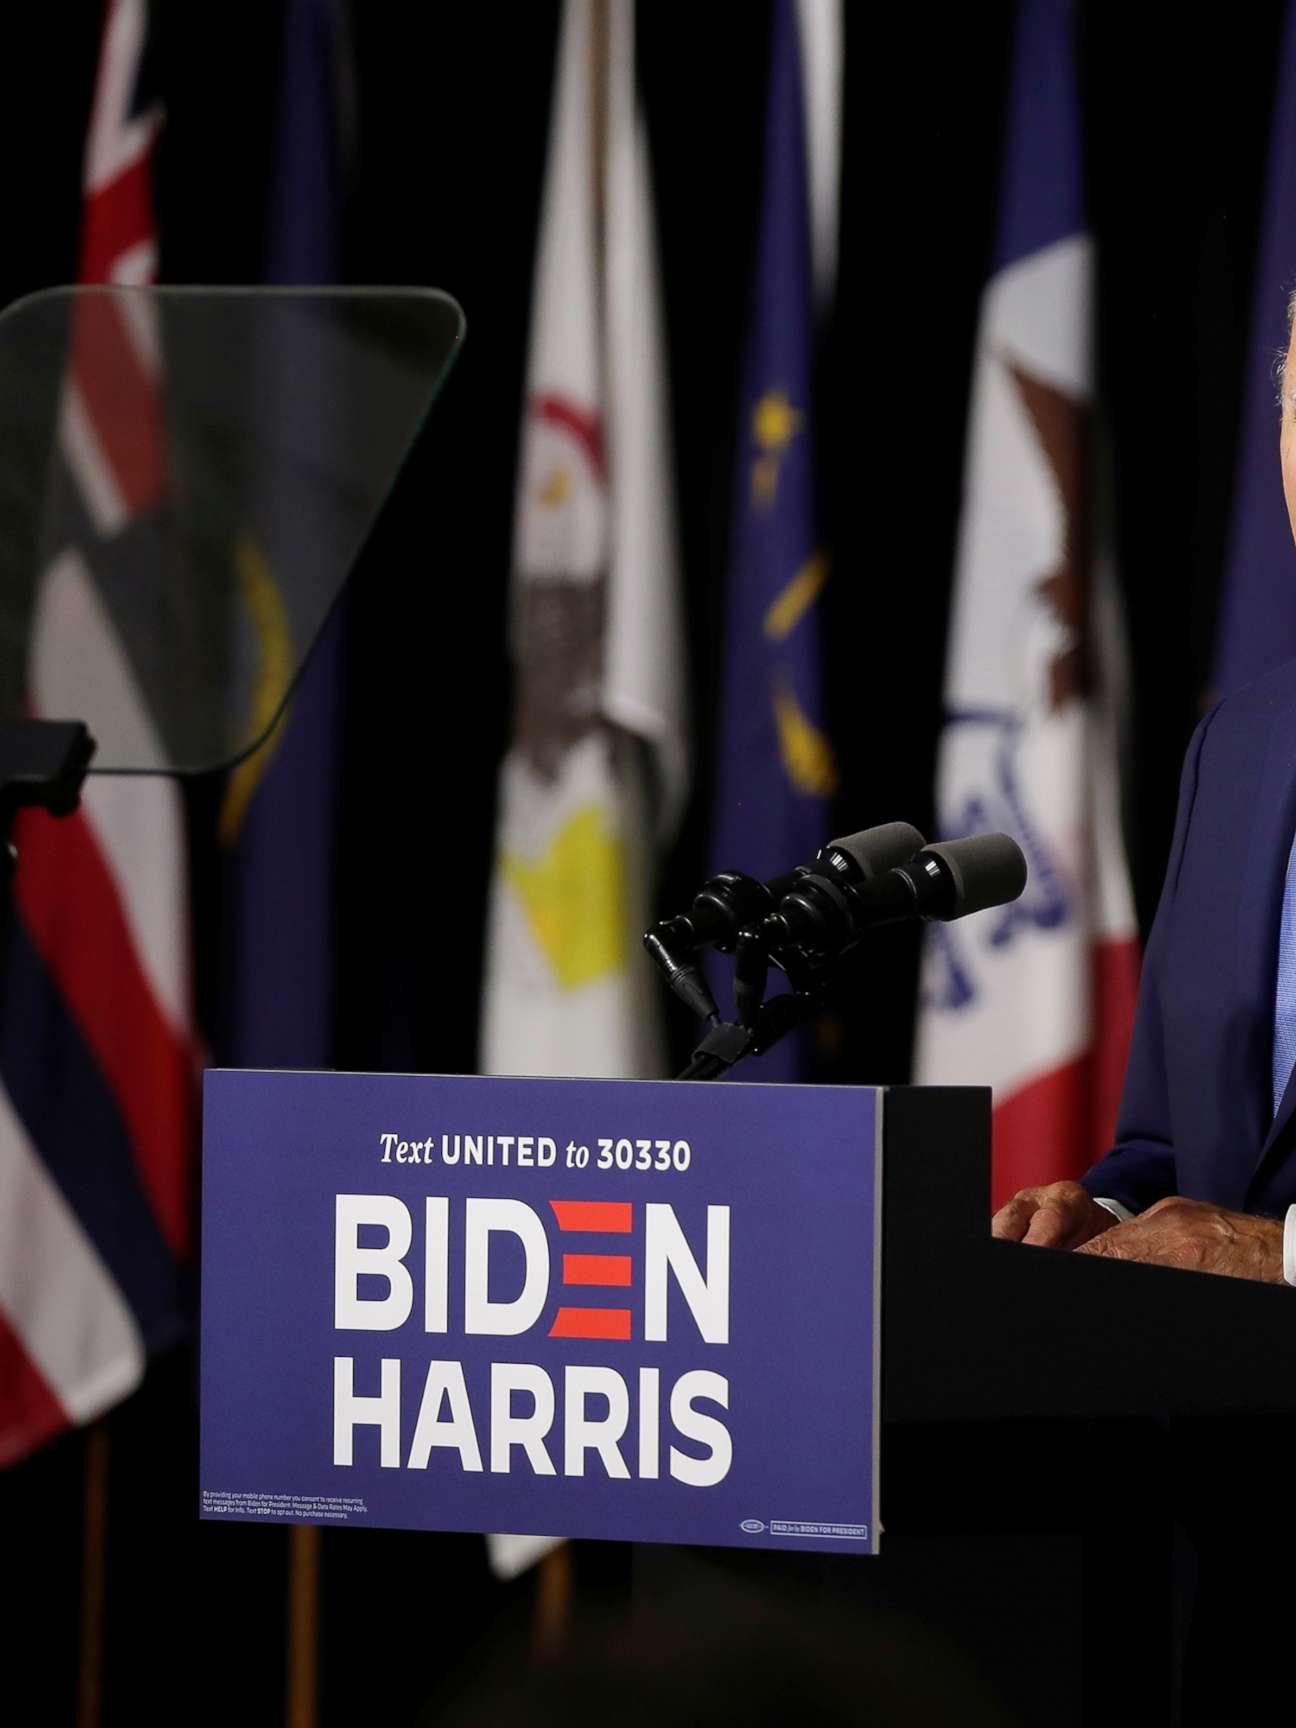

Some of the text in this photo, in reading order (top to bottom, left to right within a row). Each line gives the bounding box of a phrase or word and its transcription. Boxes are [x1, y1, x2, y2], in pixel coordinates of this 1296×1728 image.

[379, 1133, 691, 1172] Text UNITED to 30330
[334, 1193, 731, 1345] BIDEN
[333, 1356, 733, 1487] HARRIS
[832, 1527, 864, 1535] PRESIDENT
